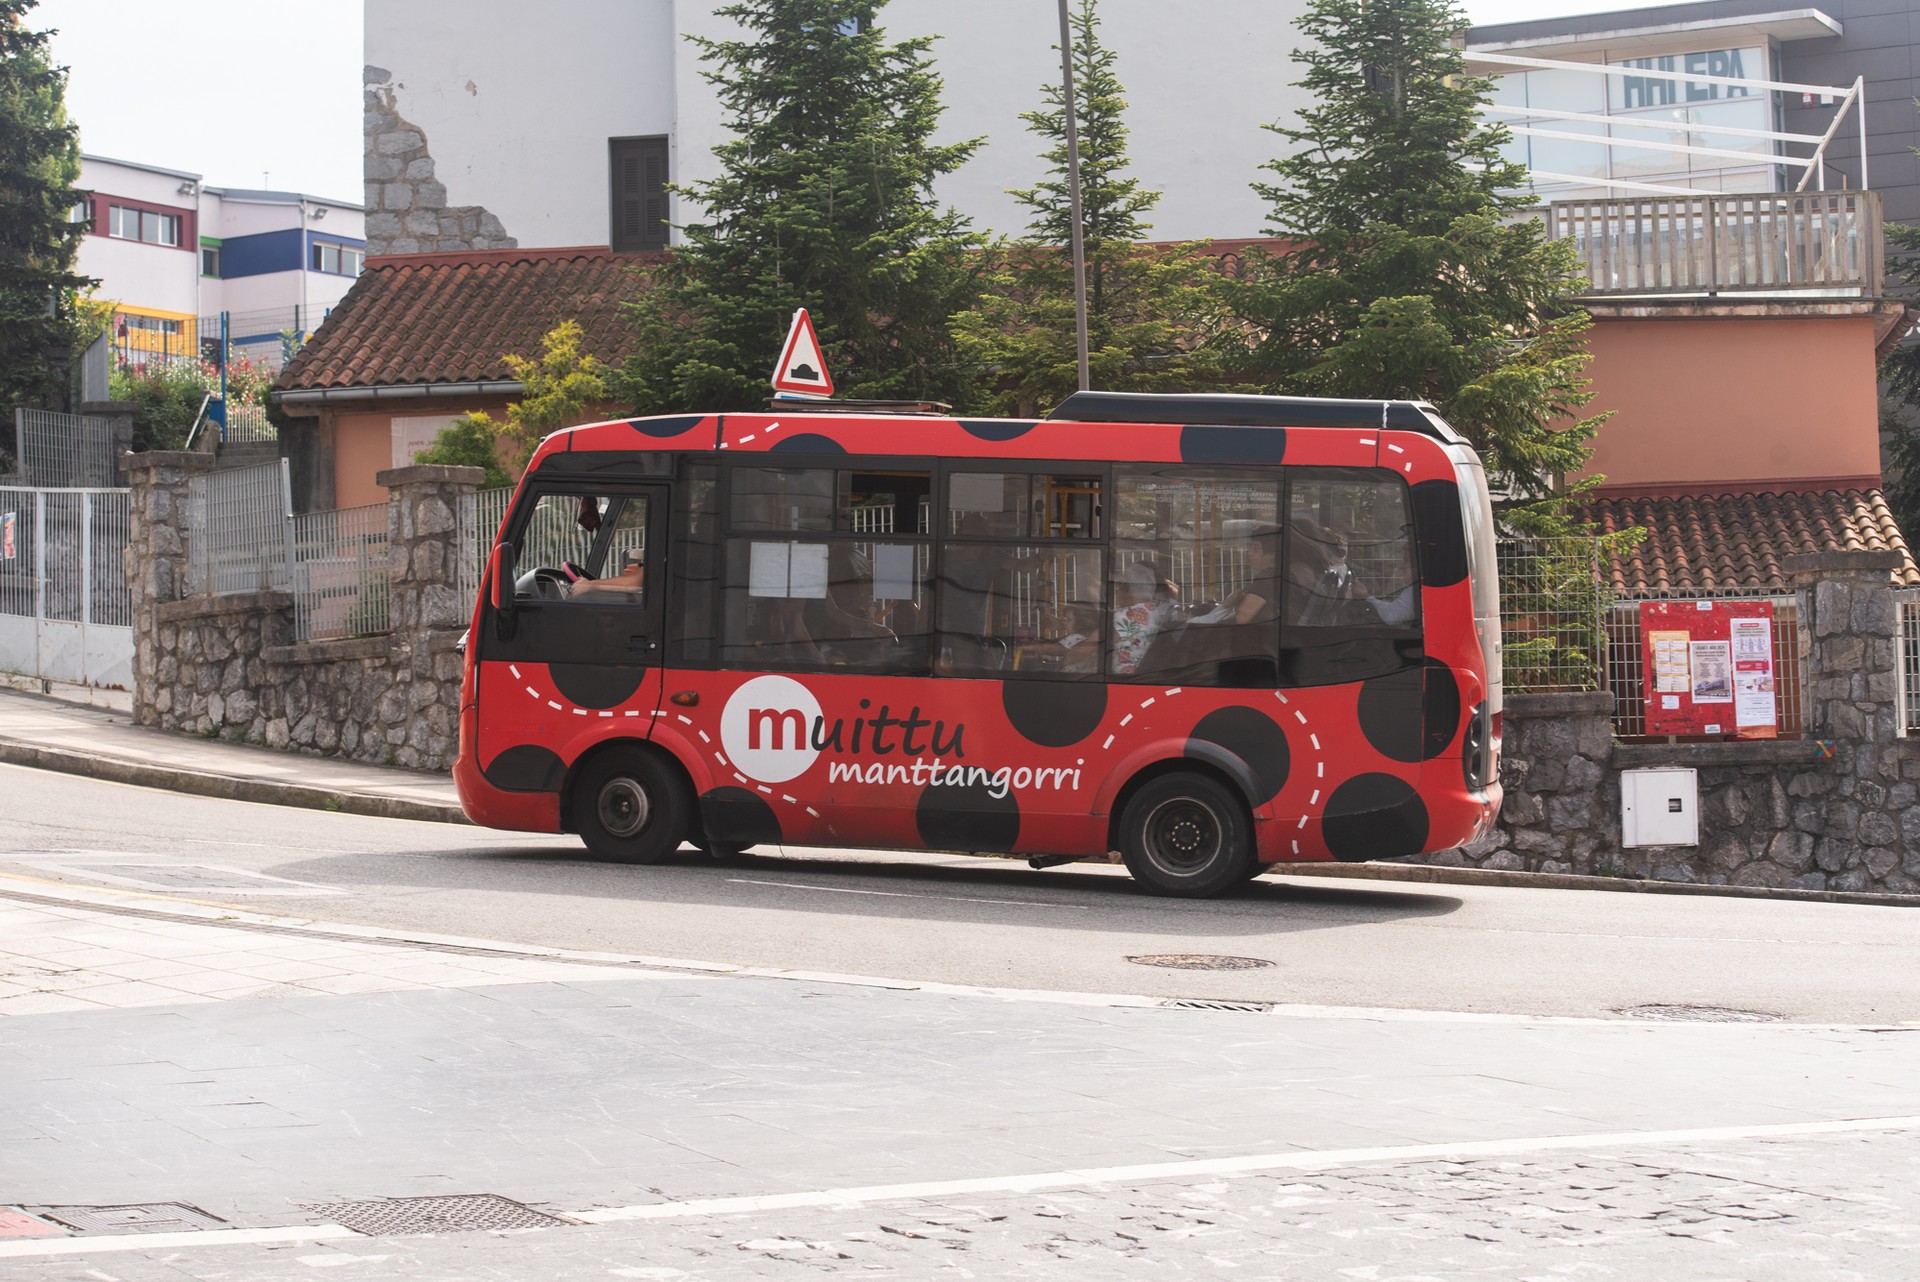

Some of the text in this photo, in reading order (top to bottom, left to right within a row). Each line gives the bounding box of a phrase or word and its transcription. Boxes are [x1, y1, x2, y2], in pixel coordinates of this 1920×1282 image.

[1684, 48, 1748, 102] EPA
[748, 699, 965, 758] muittu
[829, 757, 1084, 799] manttangorri
